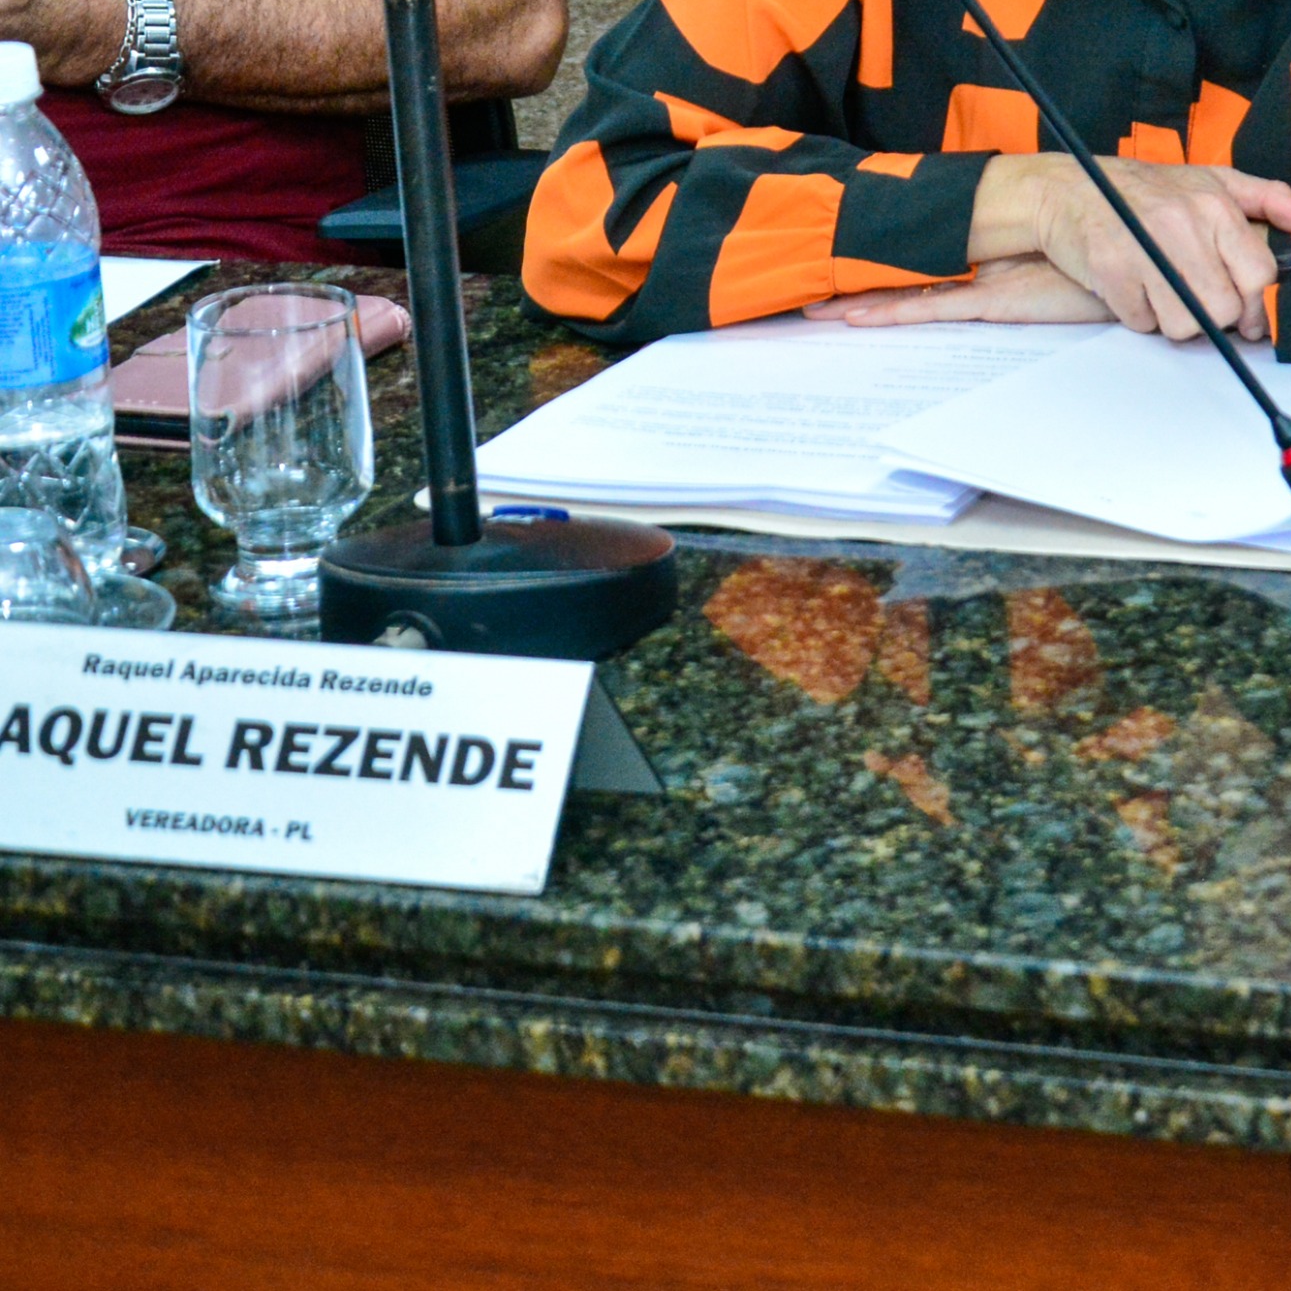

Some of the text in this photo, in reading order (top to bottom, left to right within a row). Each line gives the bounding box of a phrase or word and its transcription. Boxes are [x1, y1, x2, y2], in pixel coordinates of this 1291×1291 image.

[82, 653, 434, 698] Raquel Aparecida Rezende
[224, 717, 544, 791] REZENDE
[125, 808, 265, 837] VEREADORA
[285, 820, 312, 841] PL
